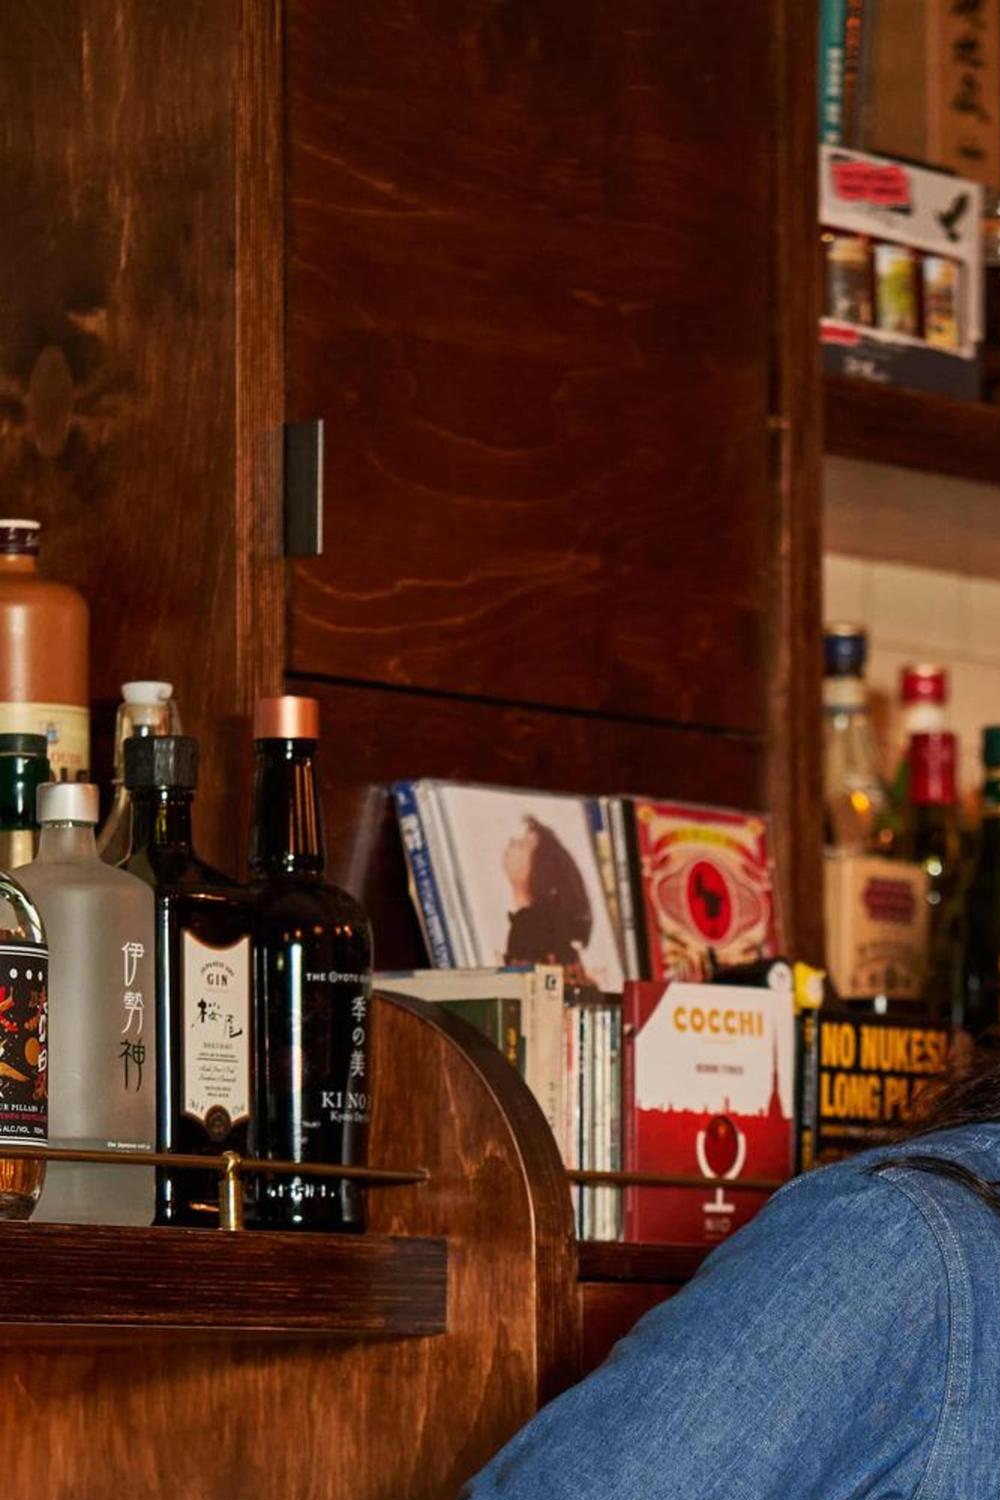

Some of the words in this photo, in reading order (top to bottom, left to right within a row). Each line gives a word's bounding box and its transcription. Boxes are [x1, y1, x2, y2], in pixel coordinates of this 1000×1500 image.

[206, 973, 228, 986] GIN
[305, 972, 326, 982] THE
[118, 941, 146, 1092] 伊勢神
[673, 1006, 765, 1037] COCCHI
[351, 996, 367, 1077] 季の美
[821, 1022, 857, 1069] NO
[322, 1091, 342, 1109] KI
[820, 1072, 881, 1120] LONG
